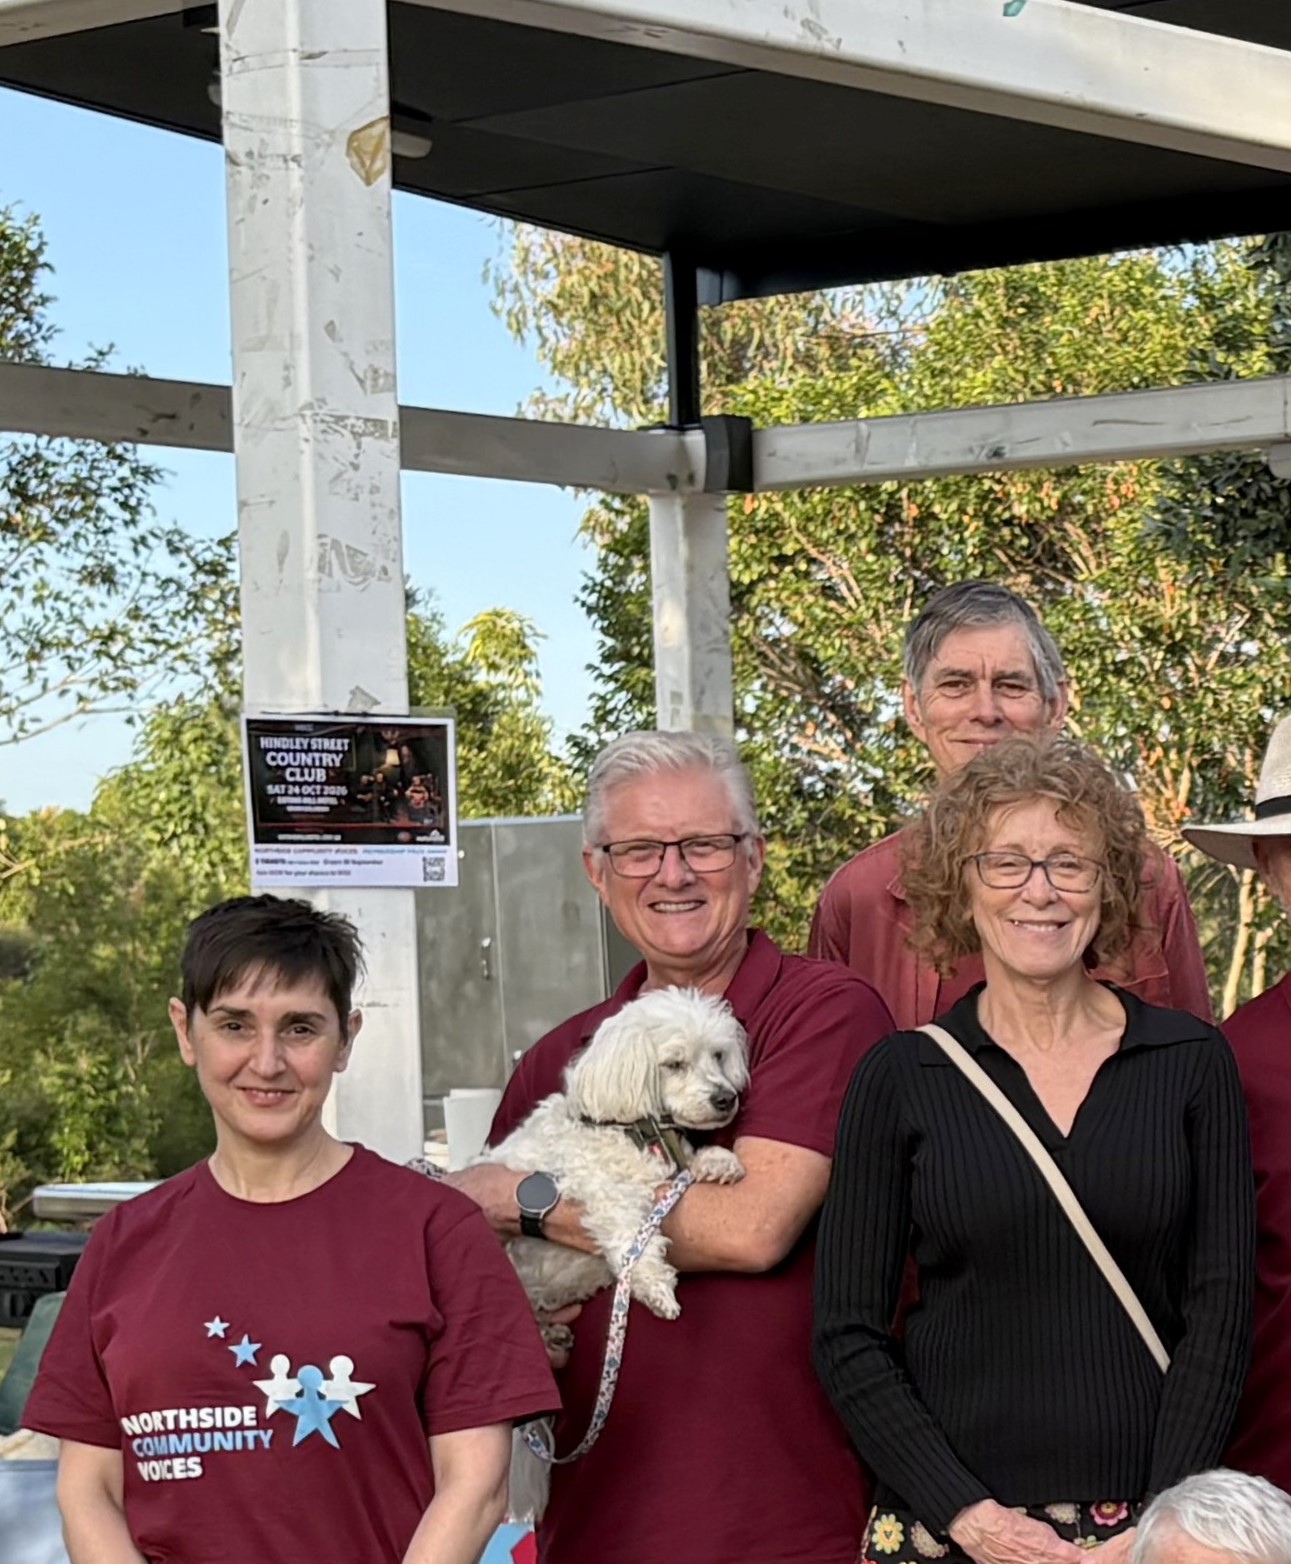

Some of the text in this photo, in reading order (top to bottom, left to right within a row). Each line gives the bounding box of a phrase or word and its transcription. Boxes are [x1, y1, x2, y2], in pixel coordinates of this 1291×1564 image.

[310, 737, 350, 751] STREET
[265, 751, 343, 767] COUNTRY
[285, 767, 326, 782] CLUB
[266, 784, 286, 795] SAT
[301, 785, 321, 796] OCT
[121, 1406, 257, 1436] NORTHSIDE
[132, 1429, 273, 1457] COMMUNITY
[137, 1457, 203, 1482] VOICES
